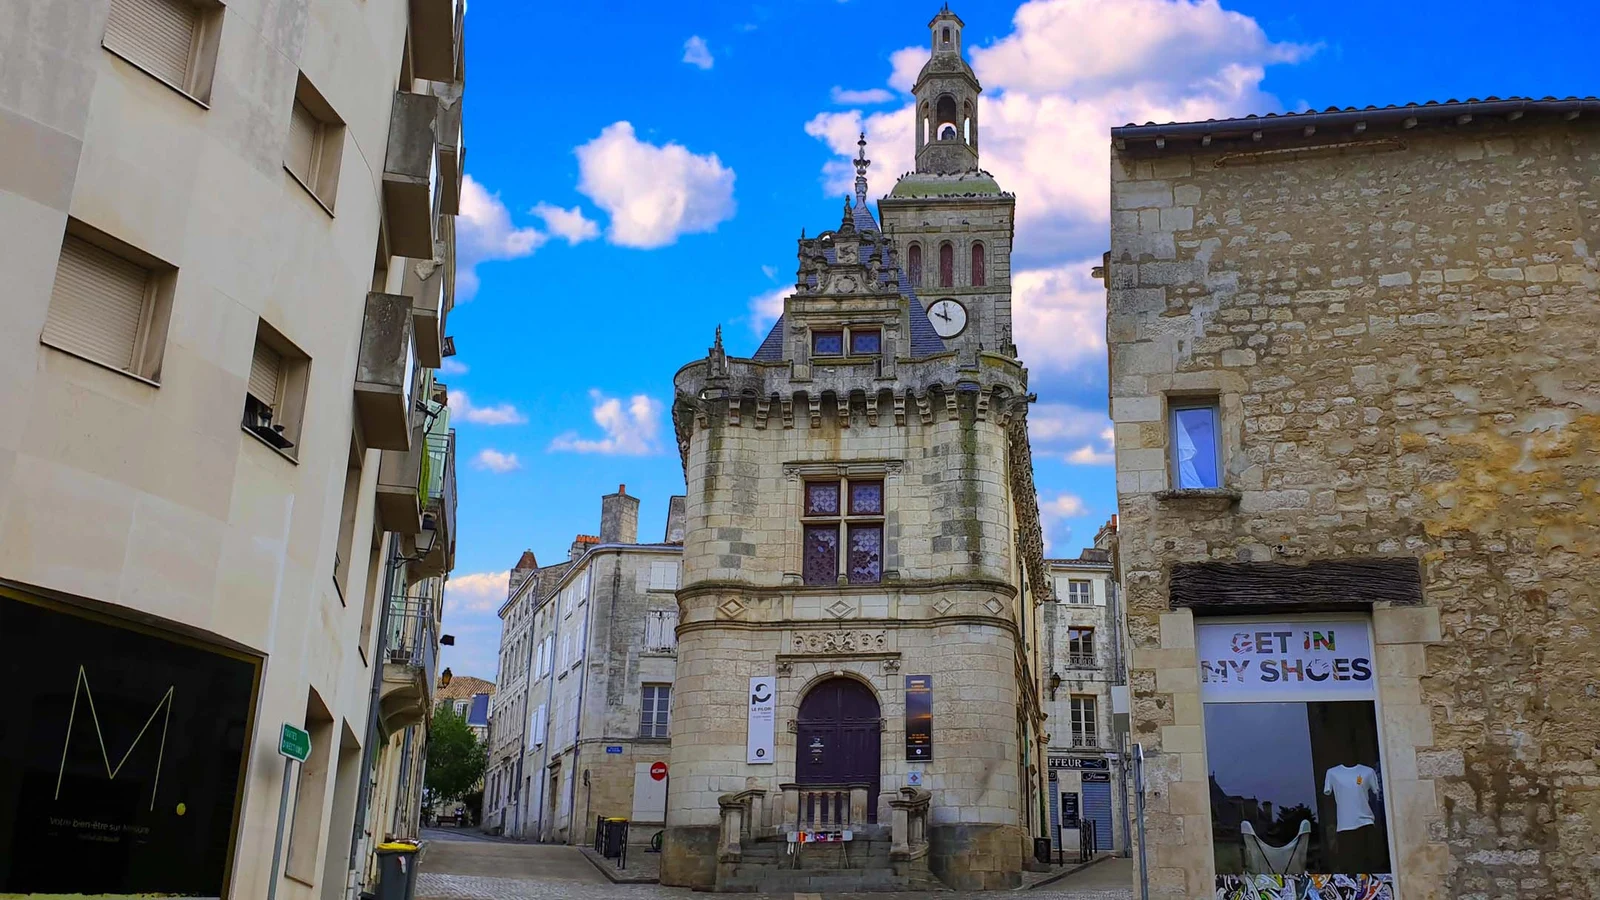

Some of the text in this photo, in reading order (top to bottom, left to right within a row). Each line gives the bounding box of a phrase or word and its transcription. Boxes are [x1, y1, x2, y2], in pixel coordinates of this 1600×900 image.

[1230, 630, 1336, 654] GET IN
[1200, 657, 1372, 683] MY SHOES
